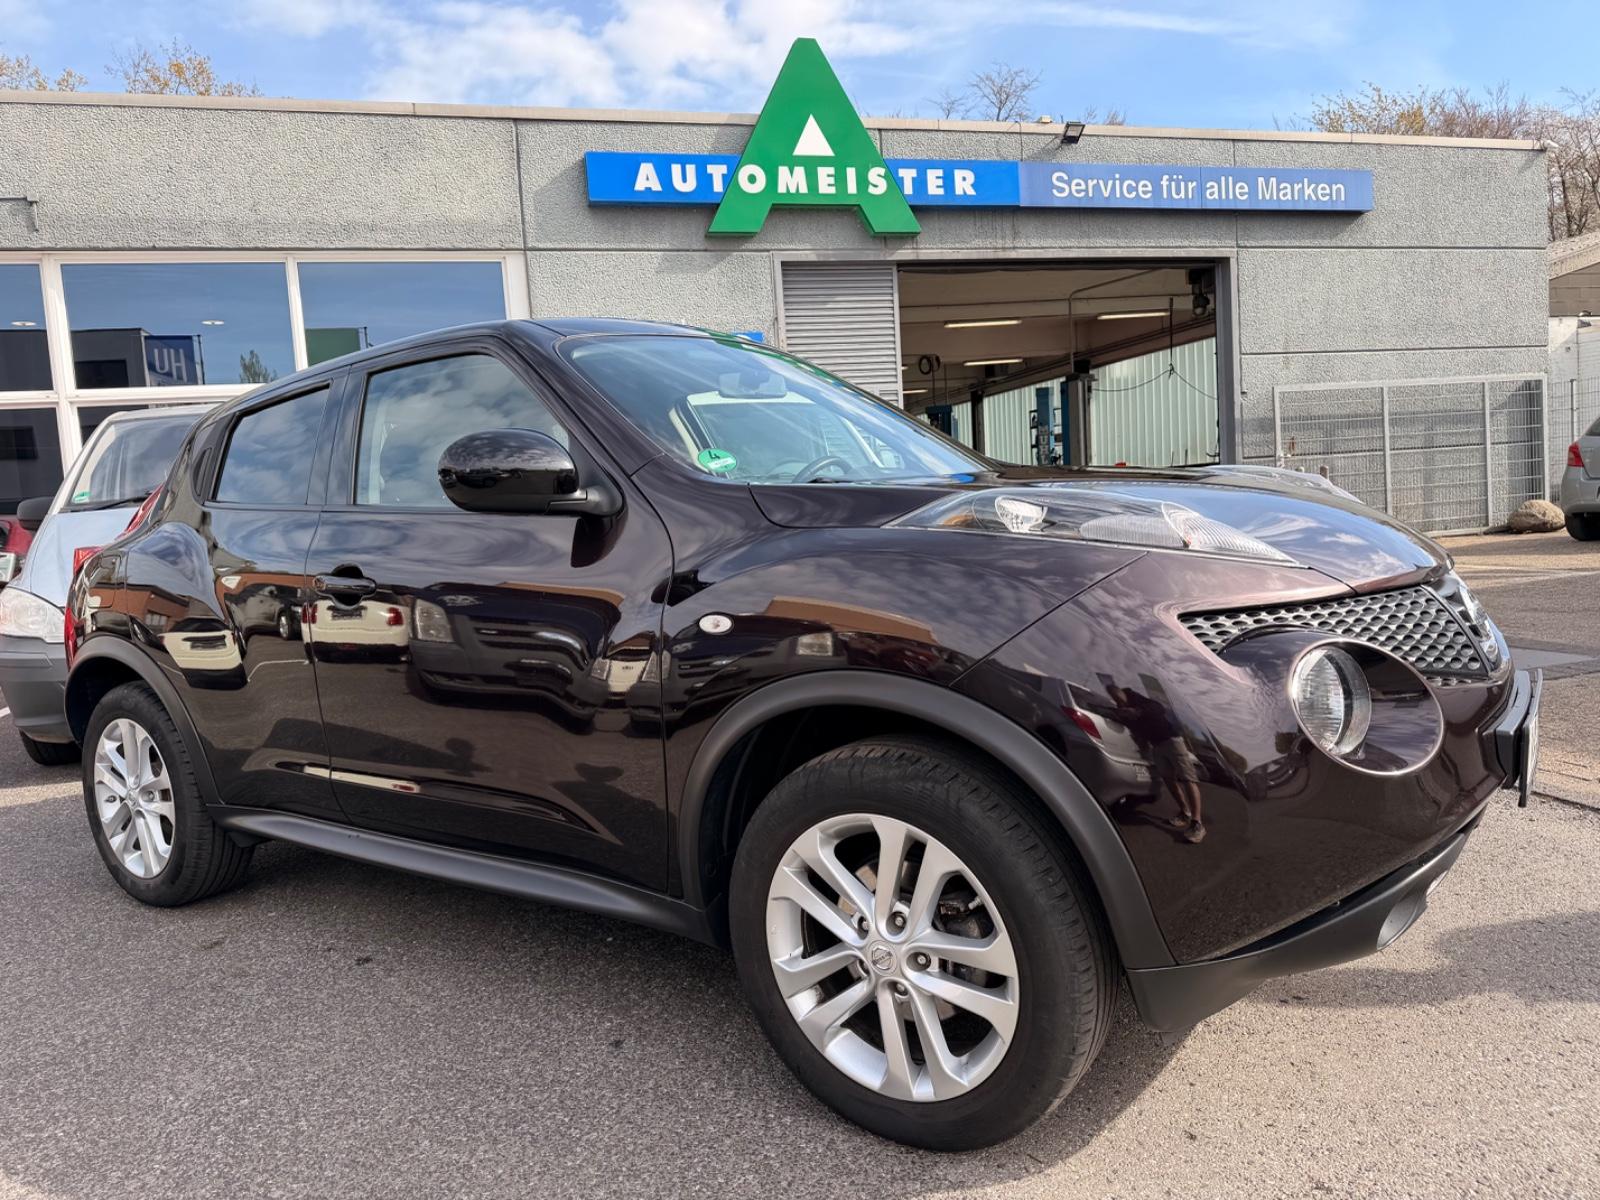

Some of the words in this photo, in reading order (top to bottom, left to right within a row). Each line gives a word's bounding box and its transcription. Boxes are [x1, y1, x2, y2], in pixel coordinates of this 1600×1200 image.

[633, 162, 977, 196] AUTOMEISTER
[1051, 171, 1153, 199] Service
[1160, 174, 1197, 199] für
[1205, 175, 1249, 200] alle
[1257, 176, 1346, 201] Marken
[708, 450, 721, 460] 4
